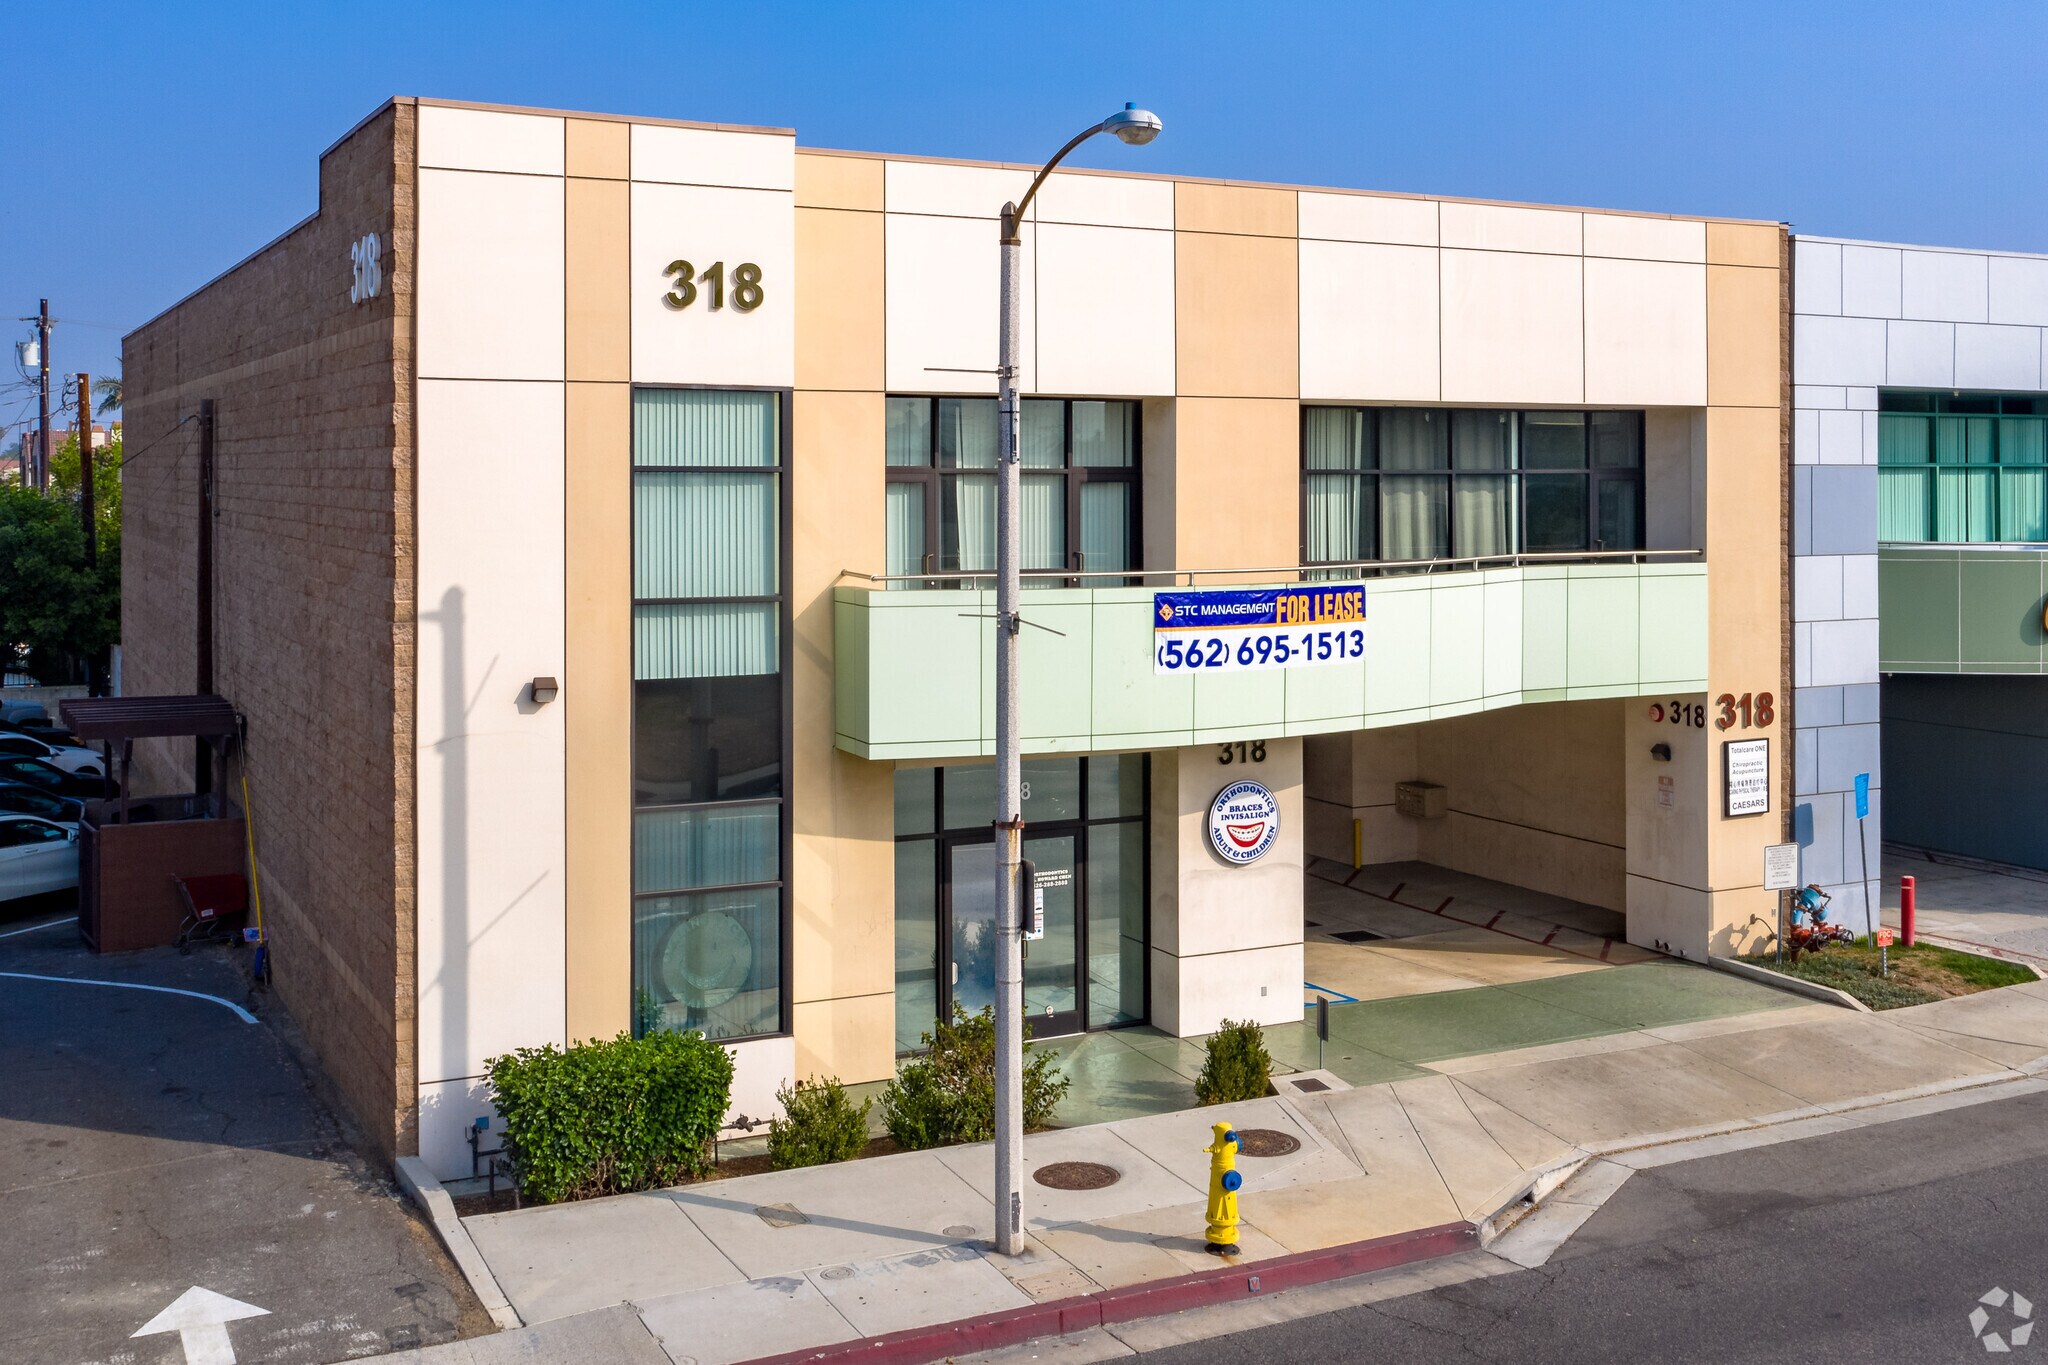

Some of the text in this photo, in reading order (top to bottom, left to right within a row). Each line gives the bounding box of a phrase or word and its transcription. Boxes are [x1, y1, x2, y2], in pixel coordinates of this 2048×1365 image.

[351, 232, 379, 304] 318
[664, 259, 764, 310] 318
[1174, 602, 1276, 617] STC MANAGEMENT
[1276, 592, 1363, 624] FOR LEASE
[1158, 629, 1364, 669] (562) 695-1513
[1670, 700, 1705, 729] 318
[1717, 692, 1775, 728] 318
[1217, 739, 1266, 765] 318
[1216, 785, 1276, 814] ORTHODONTICS
[1229, 803, 1263, 813] BRACES
[1732, 799, 1765, 810] CAESARS
[1220, 811, 1270, 821] INVISALIGN
[1214, 825, 1276, 859] ADULT & CHILDREN
[1879, 930, 1892, 938] FDC
